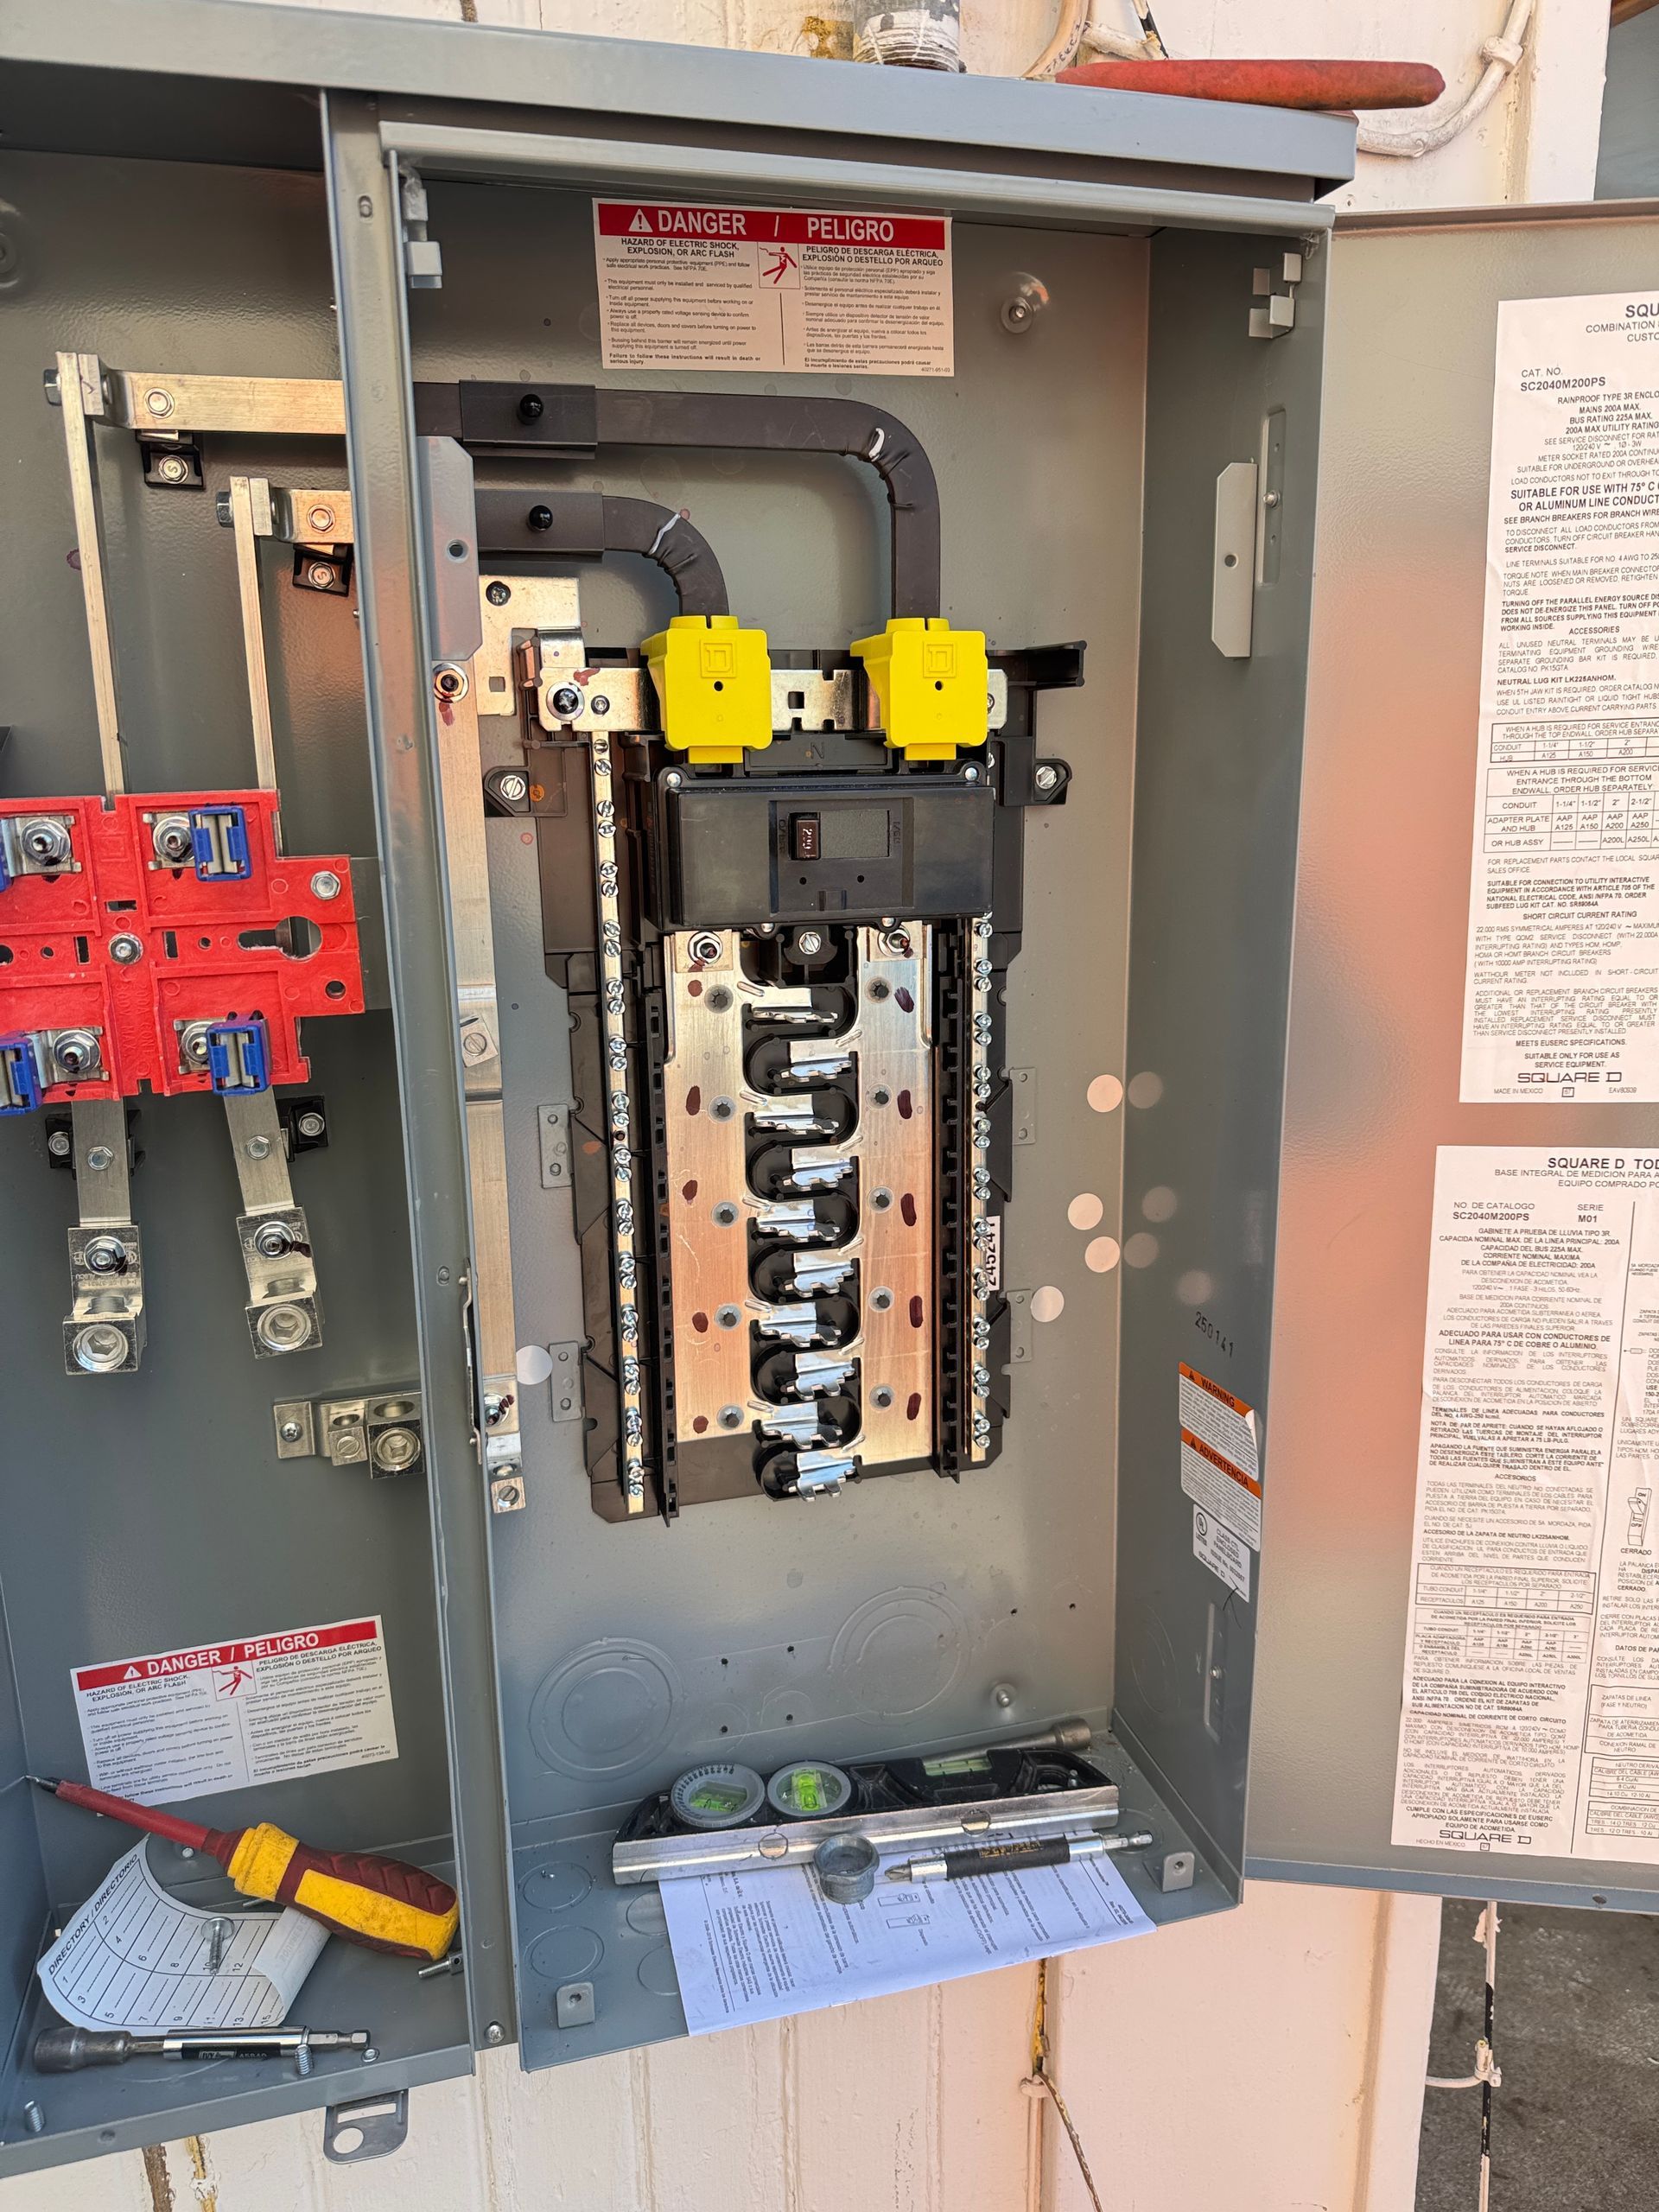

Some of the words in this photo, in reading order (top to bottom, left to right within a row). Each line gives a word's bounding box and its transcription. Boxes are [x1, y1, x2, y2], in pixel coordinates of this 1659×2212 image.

[658, 210, 747, 235] DANGER
[773, 215, 779, 237] /
[807, 217, 893, 242] PELIGRO
[627, 246, 675, 256] EXPLOSION,
[669, 239, 708, 248] ELECTRIC
[709, 241, 739, 251] SHOCK,
[806, 245, 839, 256] PELIGRO
[896, 249, 938, 258] ELÉCTRICA,
[912, 257, 943, 266] ARQUEO
[1625, 302, 1659, 318] SQU
[1586, 320, 1659, 333] COMBINATION
[1521, 368, 1543, 378] CAT.
[1546, 366, 1562, 376] NO.
[1520, 376, 1605, 391] SC2040M200PS
[1557, 394, 1600, 404] RAINPROOF
[1602, 392, 1621, 401] TYPE
[1624, 391, 1632, 400] 3R
[1569, 416, 1585, 424] BUS
[1586, 414, 1613, 423] RATING
[1602, 423, 1630, 432] UTILITY
[1510, 487, 1556, 499] SUITABLE
[1560, 486, 1579, 496] FOR
[1582, 484, 1600, 494] USE
[1604, 483, 1627, 493] WITH
[1518, 501, 1532, 512] OR
[1535, 498, 1586, 510] ALUMINUM
[1588, 497, 1610, 506] LINE
[1568, 626, 1619, 634] ACCESSORIES
[1517, 1071, 1599, 1083] SQUARE
[1605, 1071, 1622, 1082] D
[1548, 1157, 1610, 1168] SQUARE
[1614, 1158, 1624, 1168] D
[1452, 1211, 1529, 1221] SC2040M200PS
[1201, 1377, 1235, 1407] WARNING
[1199, 1445, 1249, 1487] ADVERTENCIA
[1213, 1541, 1242, 1568] PANELBOARD
[1198, 1551, 1219, 1573] SQUARE
[1220, 1569, 1225, 1578] D
[147, 1649, 221, 1675] DANGER
[230, 1646, 234, 1661] /
[244, 1632, 318, 1658] PELIGRO
[258, 1656, 289, 1665] PELIGRO
[300, 1648, 337, 1658] DESCARGA
[302, 1654, 336, 1664] DESTELLO
[353, 1645, 381, 1655] ARQUEO
[86, 1687, 116, 1697] HAZARD
[128, 1678, 162, 1689] ELECTRIC
[92, 1690, 131, 1701] EXPLOSION,
[1439, 1829, 1511, 1842] SQUARE
[1516, 1835, 1531, 1844] D
[48, 1916, 90, 1976] DIRECTORY
[94, 1854, 137, 1911] DIRECTORIO
[103, 1916, 110, 1925] 2
[116, 1936, 122, 1944] 4
[232, 1962, 244, 1972] 12
[78, 1995, 86, 2004] 3
[232, 2017, 244, 2026] 13
[261, 2014, 271, 2024] 15
